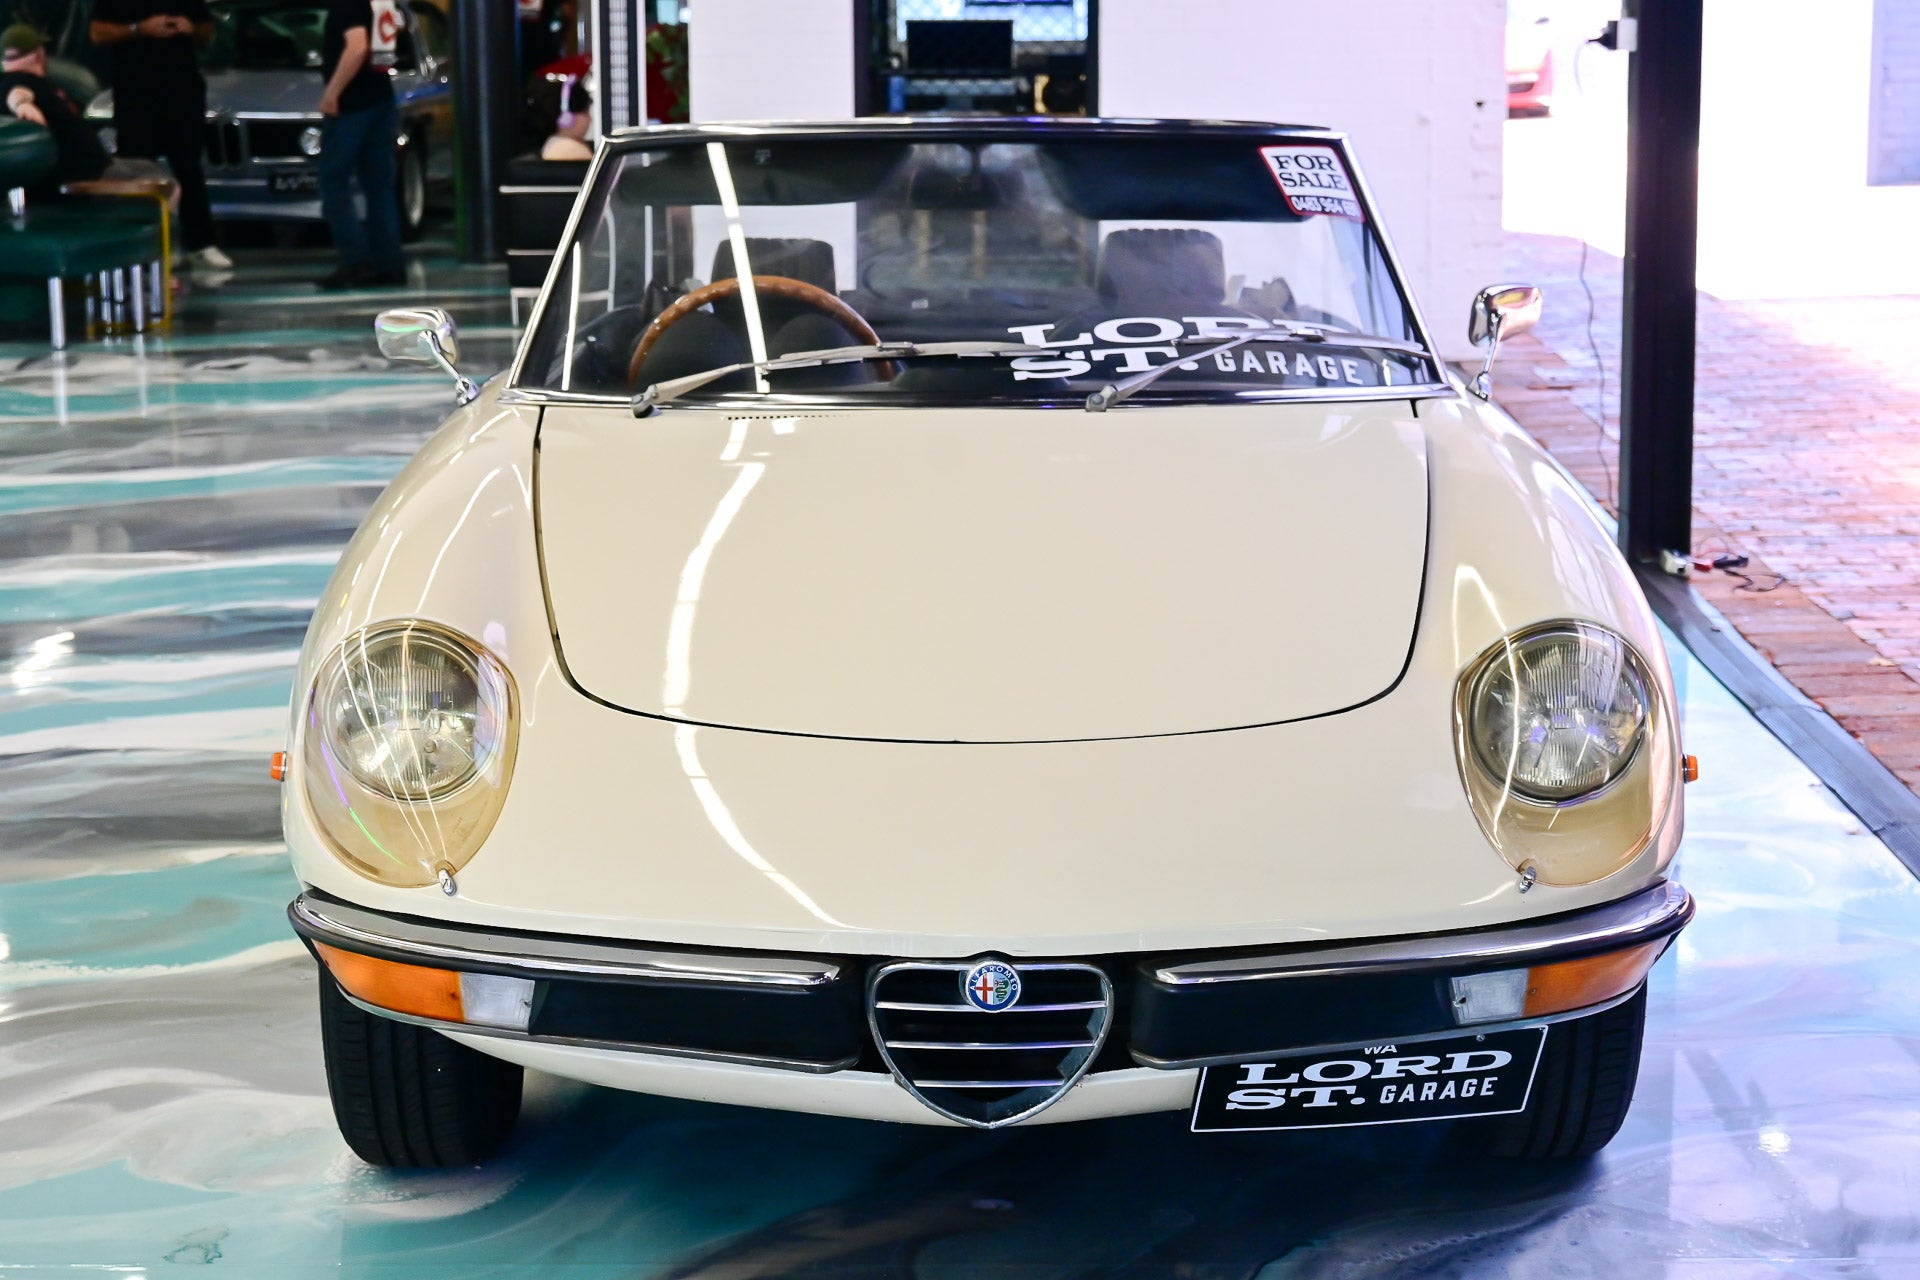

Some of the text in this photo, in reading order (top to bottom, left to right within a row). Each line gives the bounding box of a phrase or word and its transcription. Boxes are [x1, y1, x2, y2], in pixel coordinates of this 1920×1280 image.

[1272, 155, 1336, 170] FOR
[1279, 172, 1348, 191] SALE
[1010, 346, 1364, 385] ST. GARAGE
[1364, 1044, 1398, 1055] WA
[1236, 1050, 1511, 1084] LORD
[1225, 1076, 1499, 1111] ST. GARAGE
